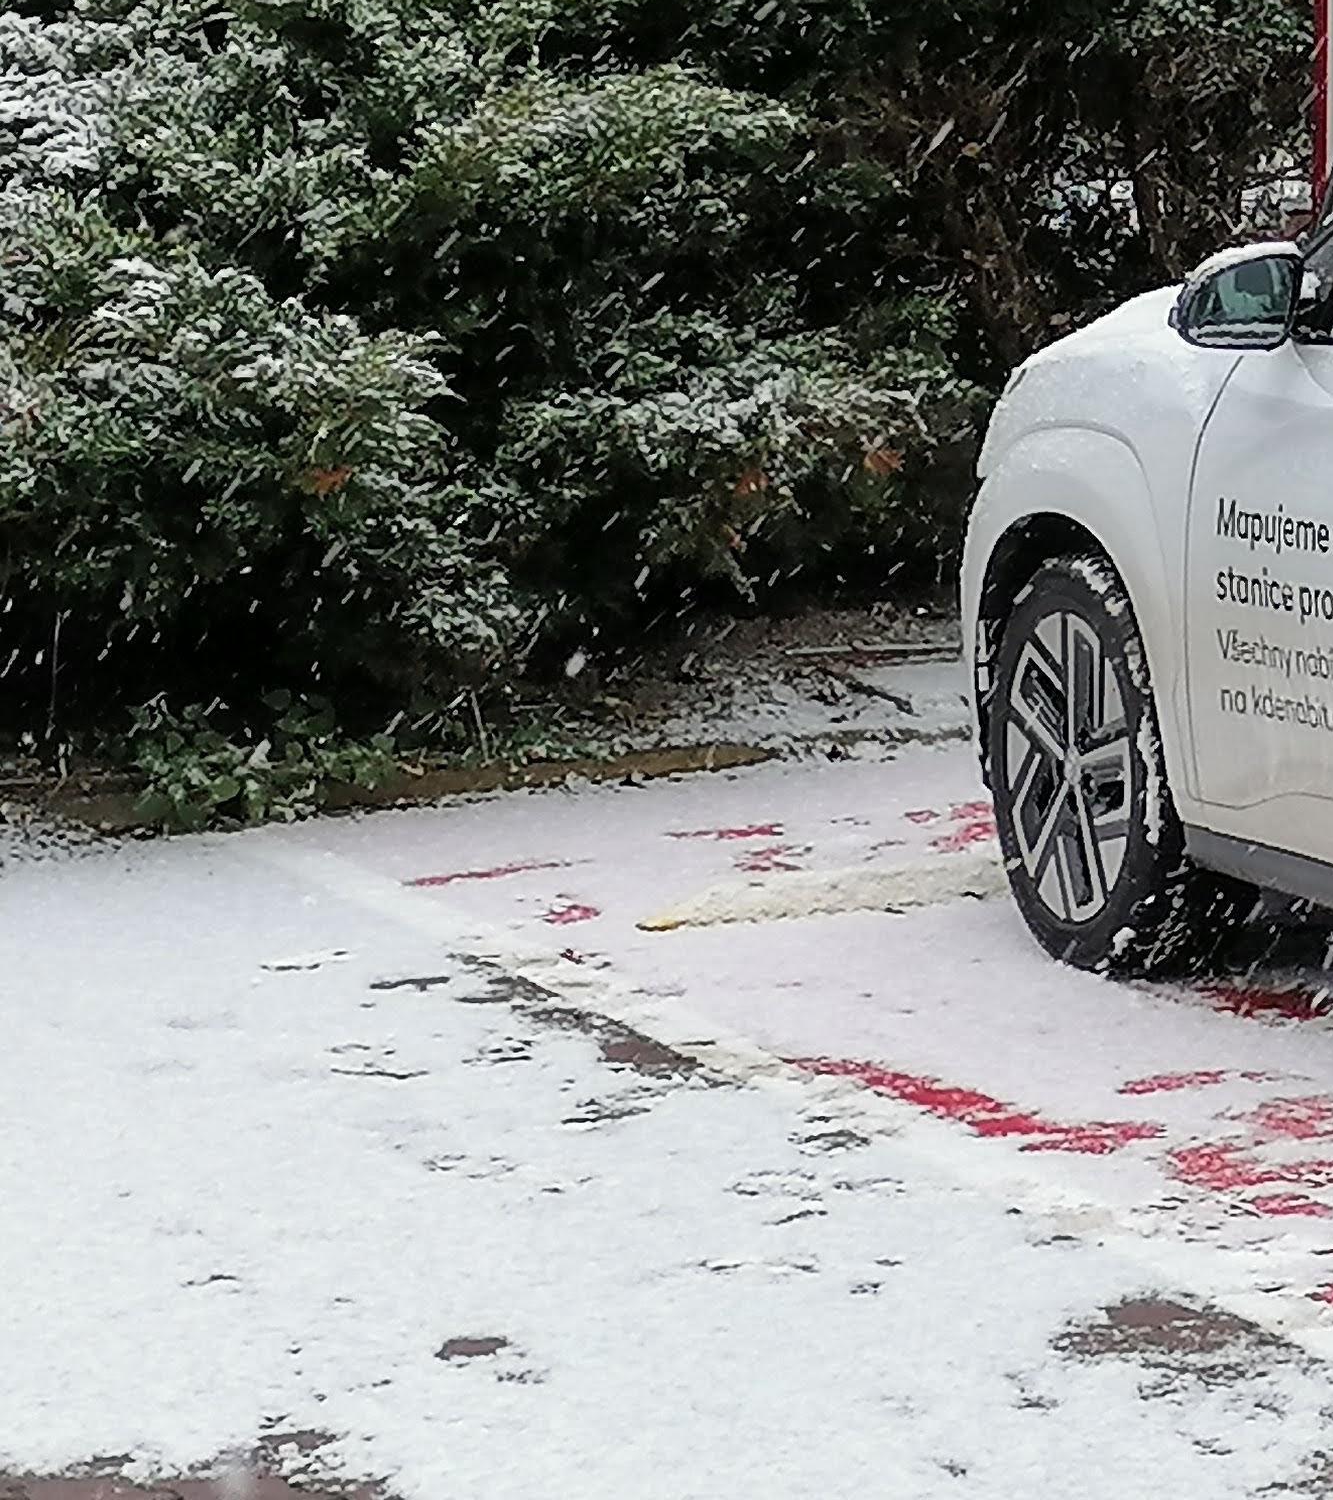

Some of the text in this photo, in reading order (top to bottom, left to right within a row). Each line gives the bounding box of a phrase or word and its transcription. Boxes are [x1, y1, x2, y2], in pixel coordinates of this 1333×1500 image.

[1216, 497, 1330, 554] Mapujeme
[1216, 566, 1294, 612] stanice
[1215, 628, 1292, 678] Všechny
[1220, 687, 1247, 714] na
